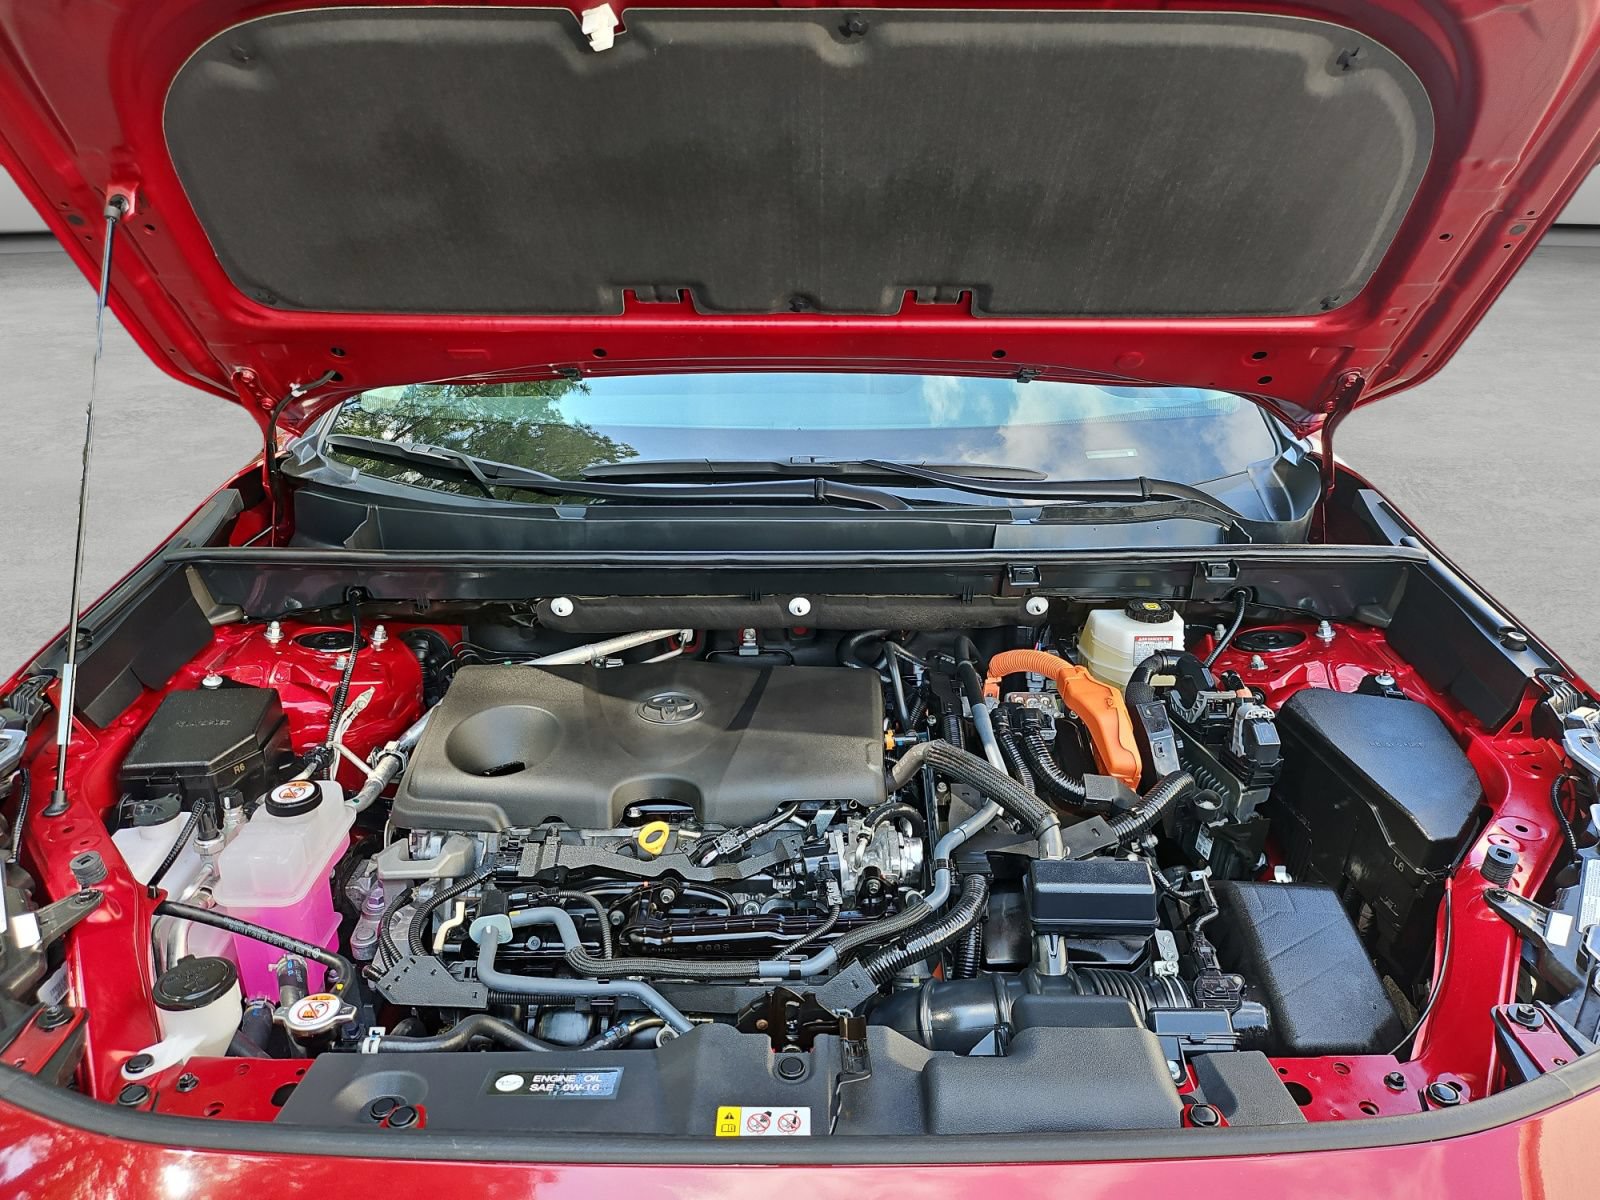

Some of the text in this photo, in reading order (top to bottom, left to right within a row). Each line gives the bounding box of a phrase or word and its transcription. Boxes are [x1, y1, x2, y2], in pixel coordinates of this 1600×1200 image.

[233, 763, 246, 775] R6
[1393, 856, 1405, 873] L6
[532, 1074, 602, 1083] ENGINE OIL
[529, 1083, 600, 1092] SAE 0W-16
